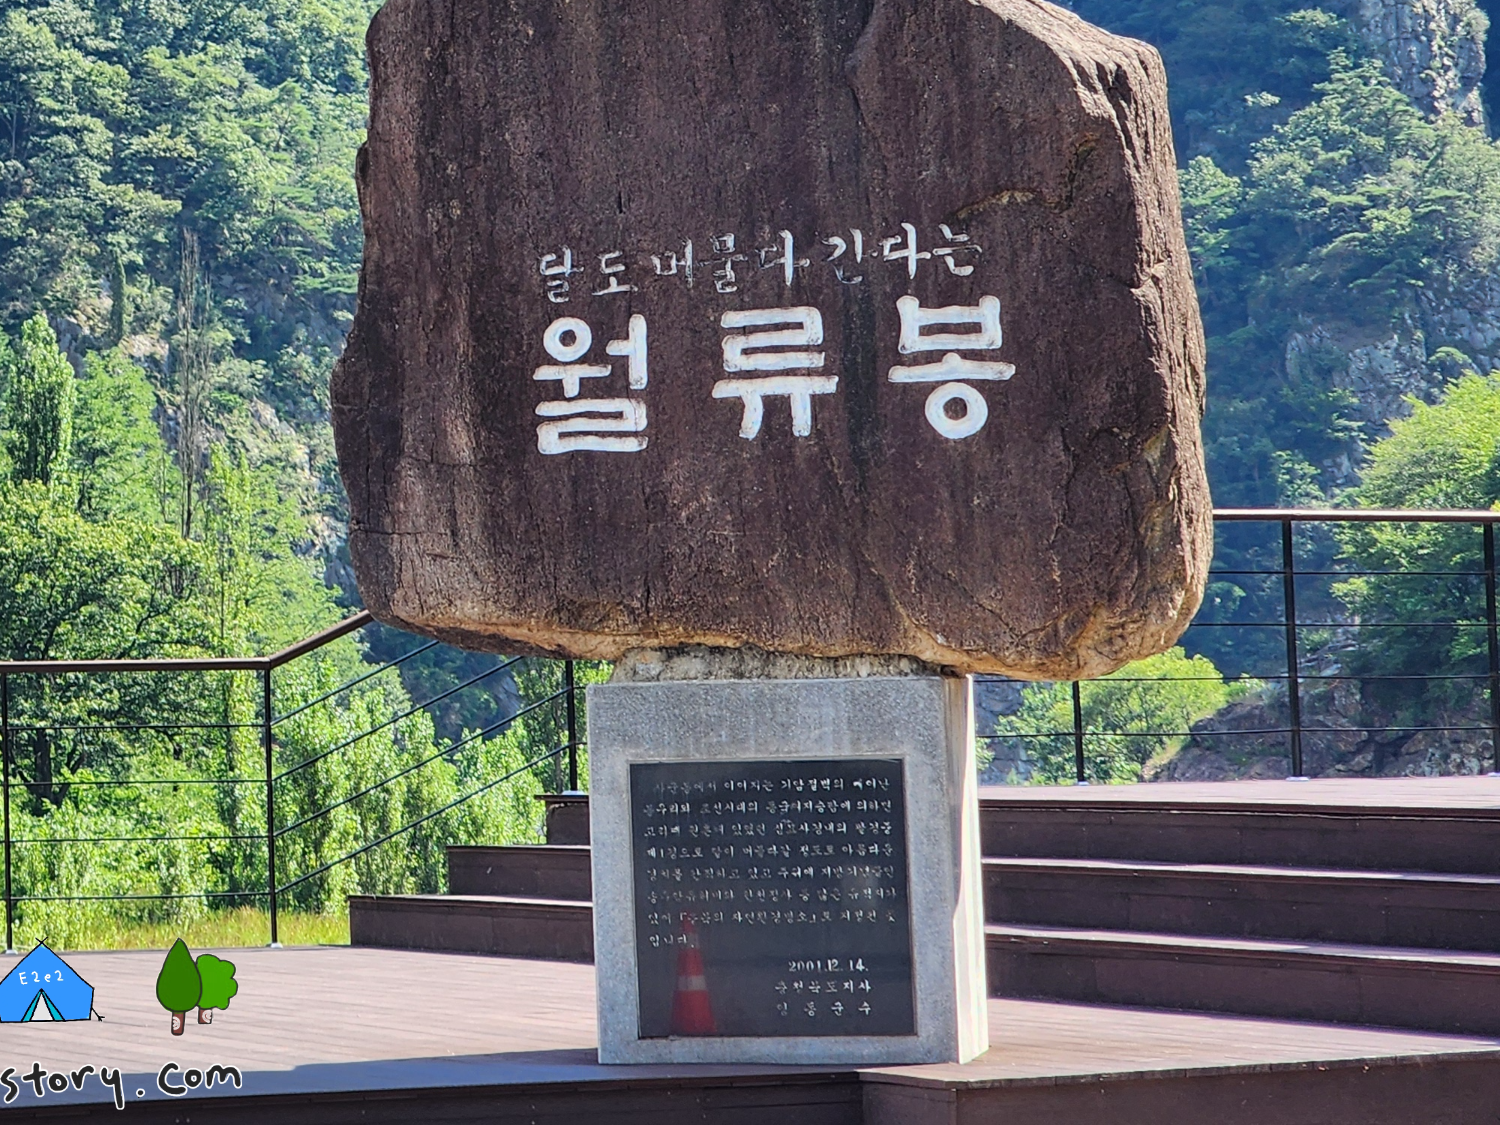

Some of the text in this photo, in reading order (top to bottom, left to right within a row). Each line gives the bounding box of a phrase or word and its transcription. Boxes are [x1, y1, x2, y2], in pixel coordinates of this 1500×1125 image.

[537, 222, 984, 303] 달도 머물다 간다는
[533, 295, 1017, 455] 월류봉
